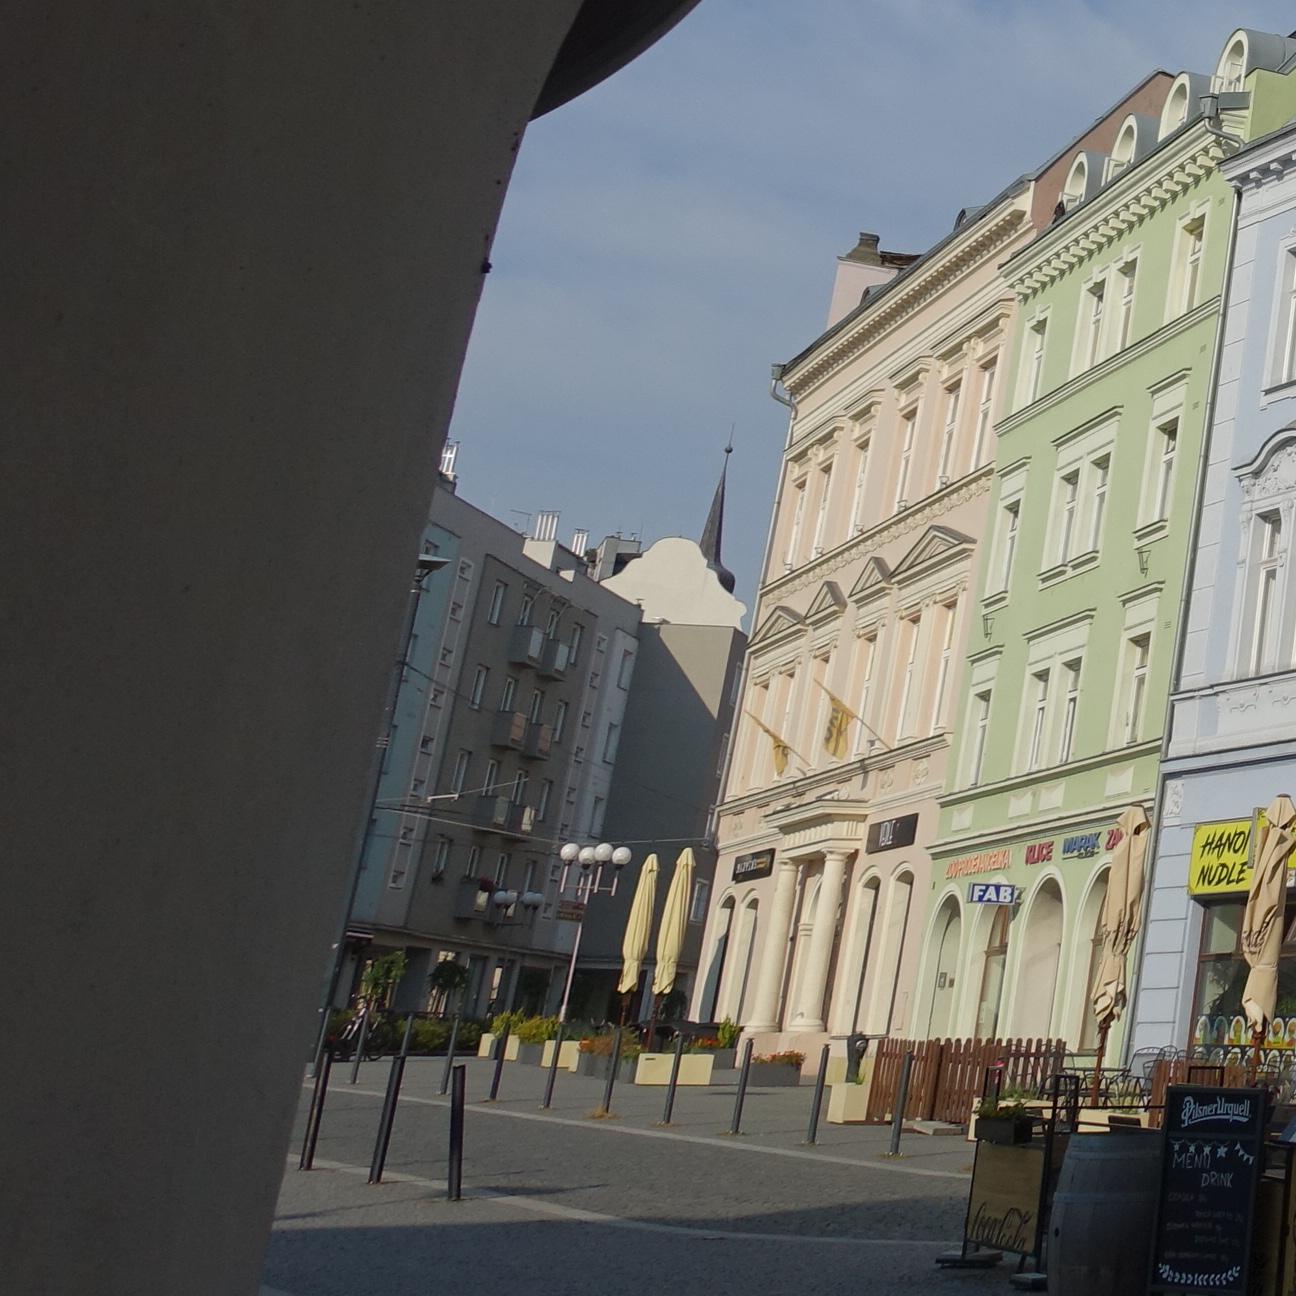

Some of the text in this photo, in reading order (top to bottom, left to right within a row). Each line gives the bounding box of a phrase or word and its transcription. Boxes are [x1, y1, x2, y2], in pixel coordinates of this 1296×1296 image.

[1200, 825, 1251, 862] HANOI
[1196, 859, 1249, 888] NUDLE
[972, 885, 1013, 903] FAB
[1181, 1095, 1251, 1128] Pilsner Urquell
